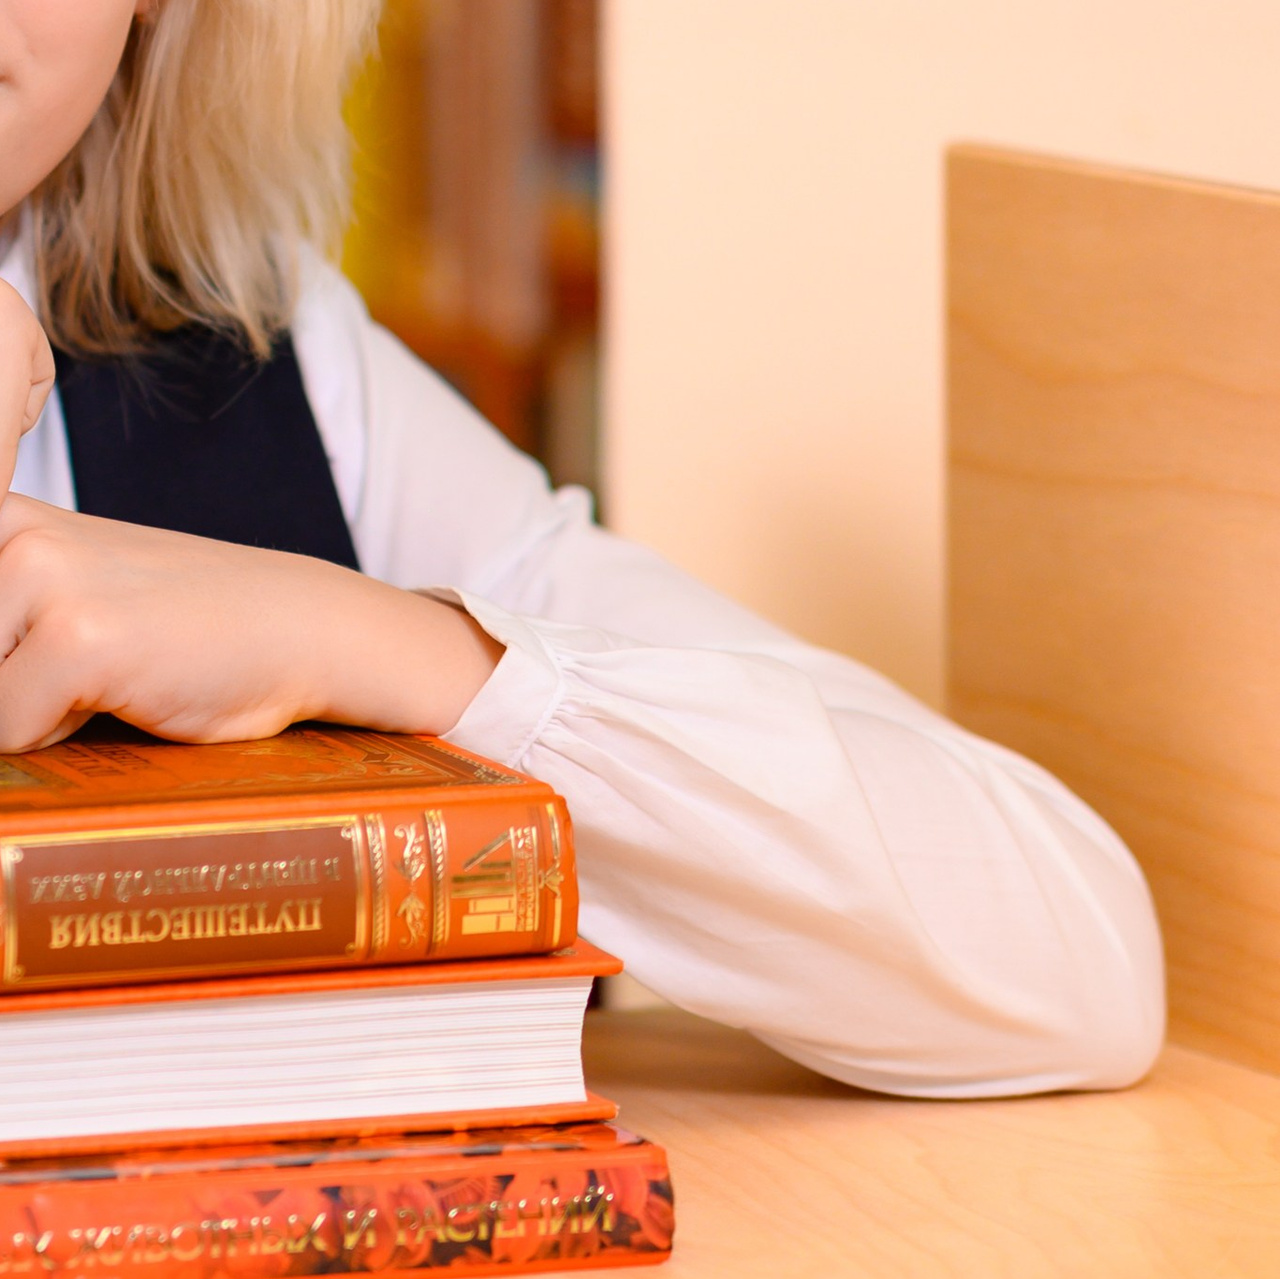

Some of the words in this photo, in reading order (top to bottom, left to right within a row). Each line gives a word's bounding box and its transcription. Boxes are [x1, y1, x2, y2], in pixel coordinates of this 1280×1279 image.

[49, 898, 324, 949] ПУТЕШЕСТВИЯ
[65, 1211, 329, 1269] ЖИВОТНЫХ
[343, 1208, 379, 1251] И
[396, 1184, 615, 1247] РАСТЕНИЙ
